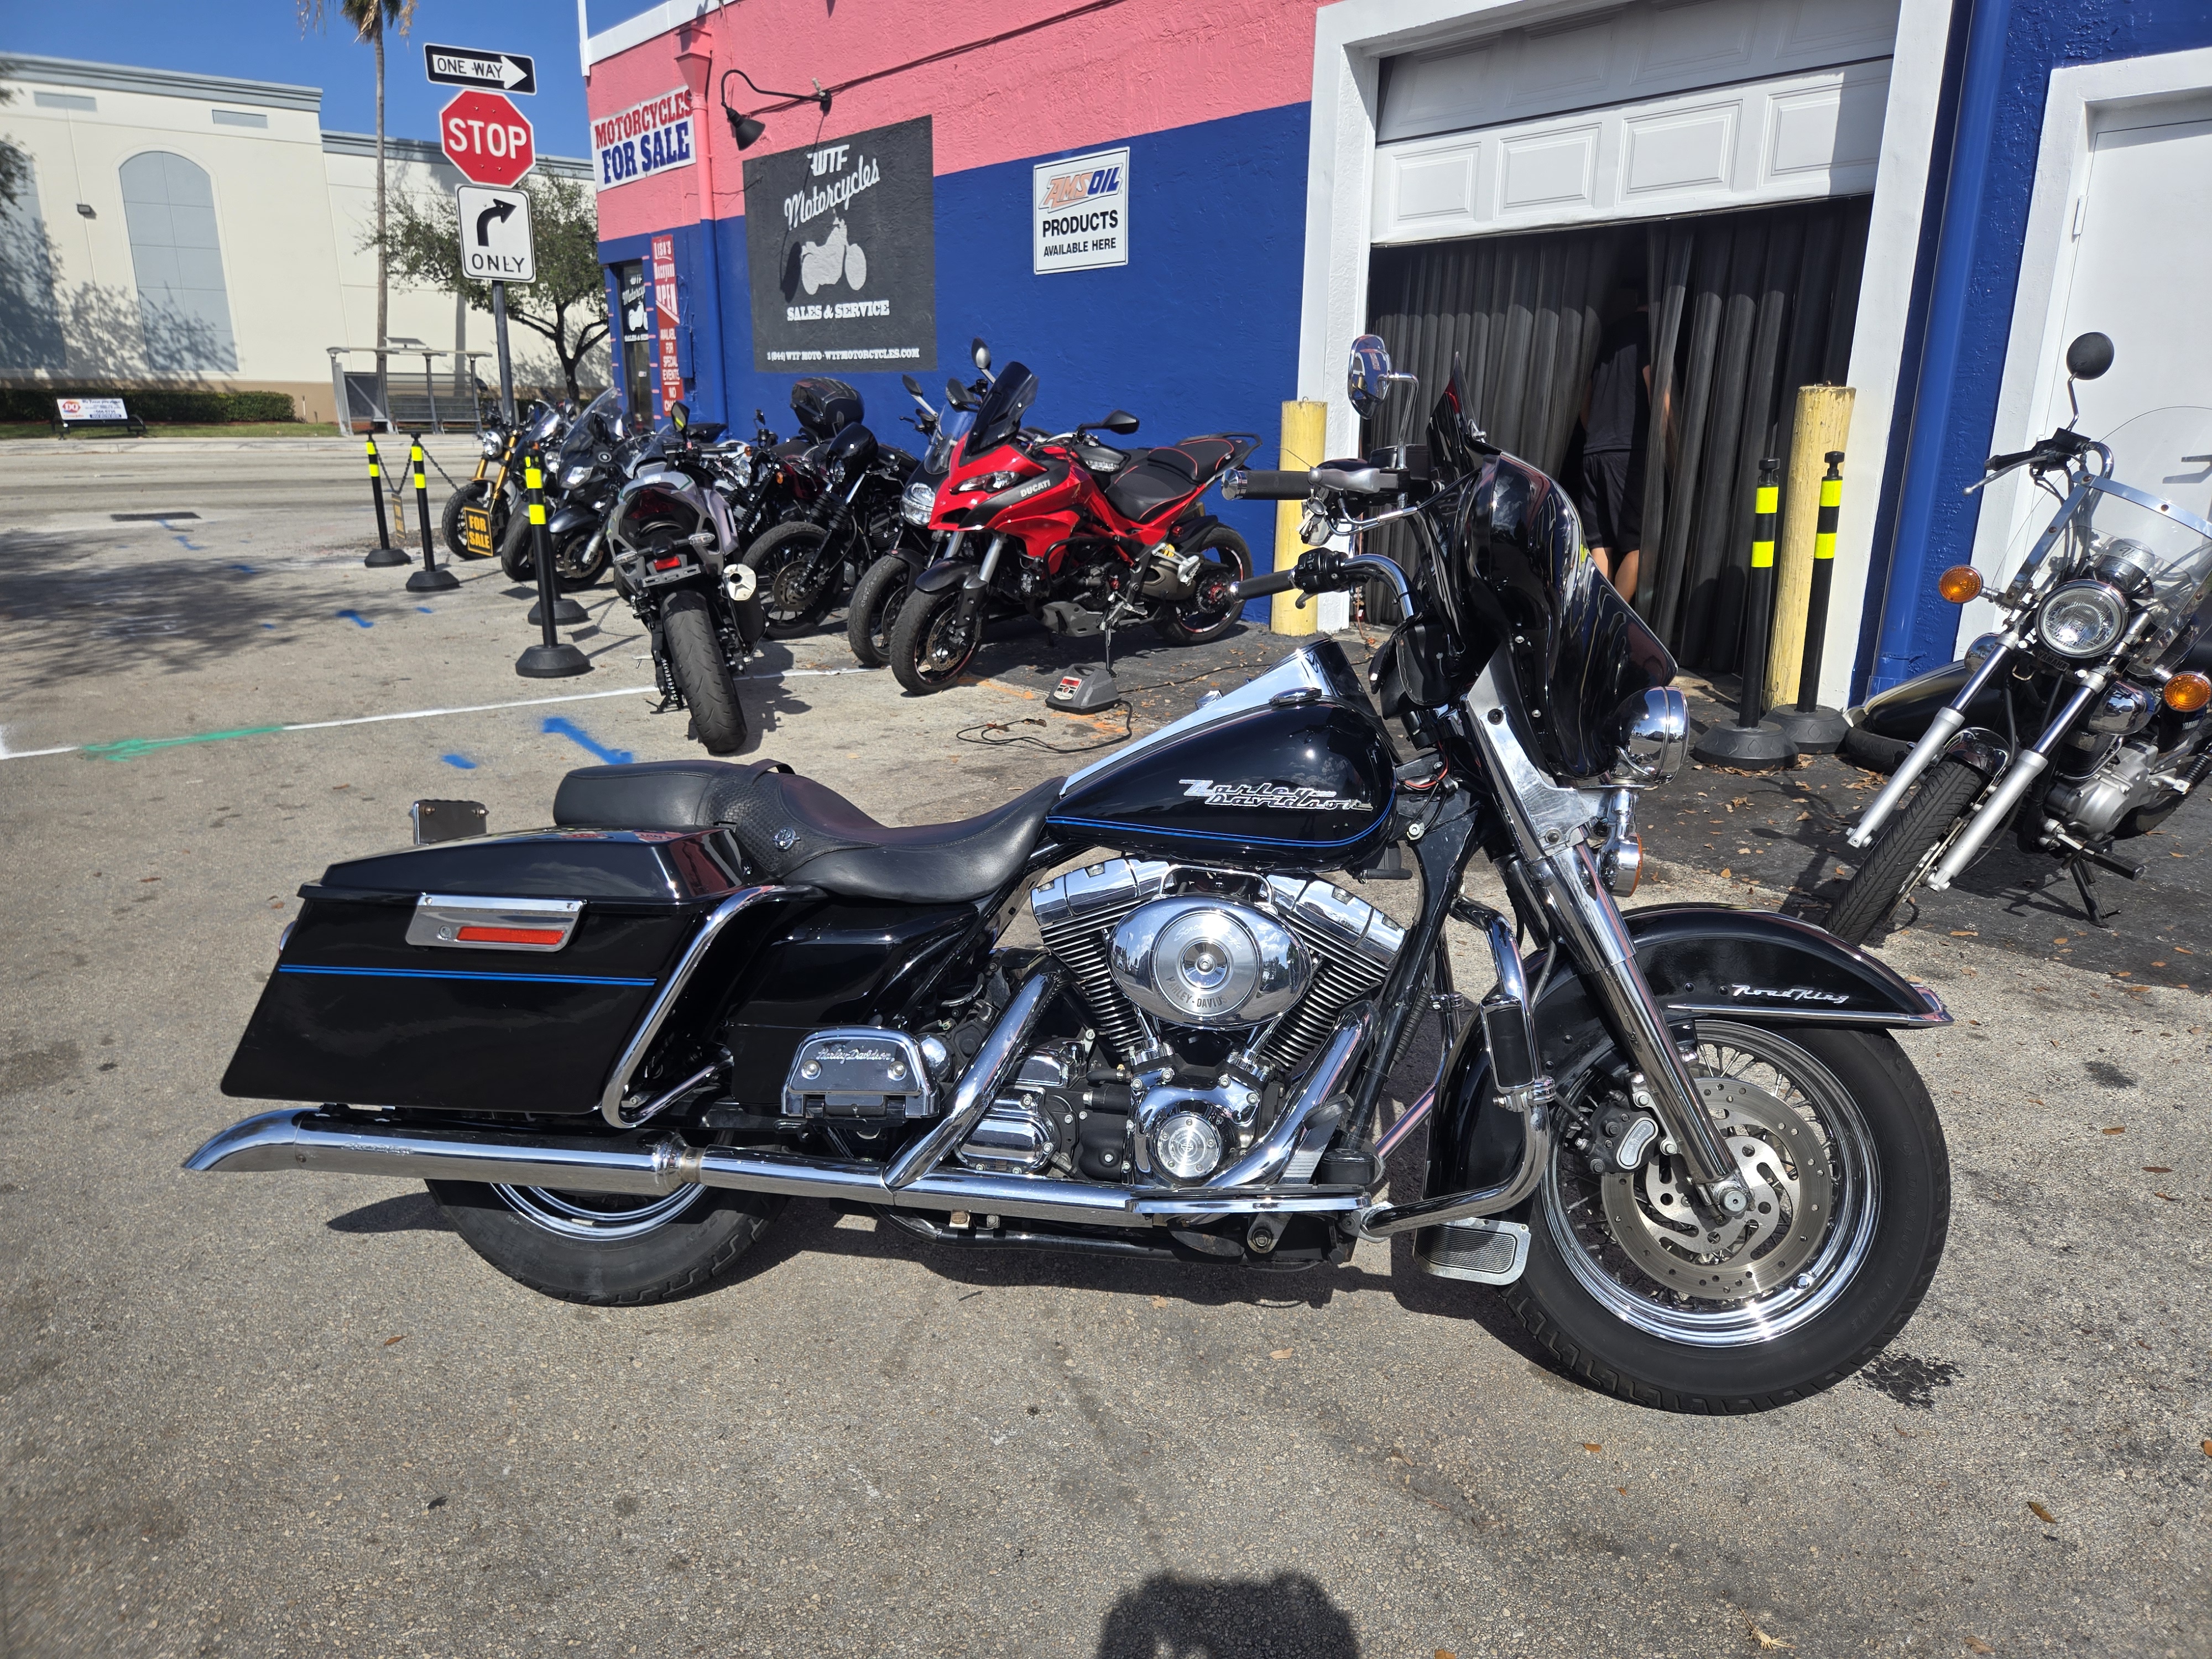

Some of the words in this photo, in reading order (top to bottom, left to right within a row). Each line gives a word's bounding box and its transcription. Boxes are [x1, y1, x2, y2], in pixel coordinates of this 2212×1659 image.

[437, 58, 466, 75] ONE
[473, 64, 503, 79] WAY
[594, 88, 693, 150] MOTORCYCLES
[448, 118, 527, 159] STOP
[602, 140, 638, 185] FOR
[640, 121, 691, 173] SALE
[806, 144, 849, 176] WTF
[784, 155, 880, 231] Motorcycles
[1043, 166, 1120, 208] AMSOIL
[1042, 209, 1118, 238] PRODUCTS
[1044, 241, 1088, 257] AVAILABLE
[1092, 237, 1116, 252] HERE
[472, 253, 525, 274] ONLY
[656, 283, 678, 315] OPEN
[787, 305, 823, 321] SALES
[823, 305, 833, 319] &
[834, 300, 890, 319] SERVICE
[785, 351, 801, 361] WTF
[824, 348, 920, 360] WTFMOTORCYCLES.COM
[669, 386, 676, 399] NO
[1020, 479, 1051, 498] DUCATI
[469, 515, 487, 533] FOR
[468, 531, 491, 549] SALE
[1731, 984, 1794, 998] Road
[1794, 988, 1849, 1004] King
